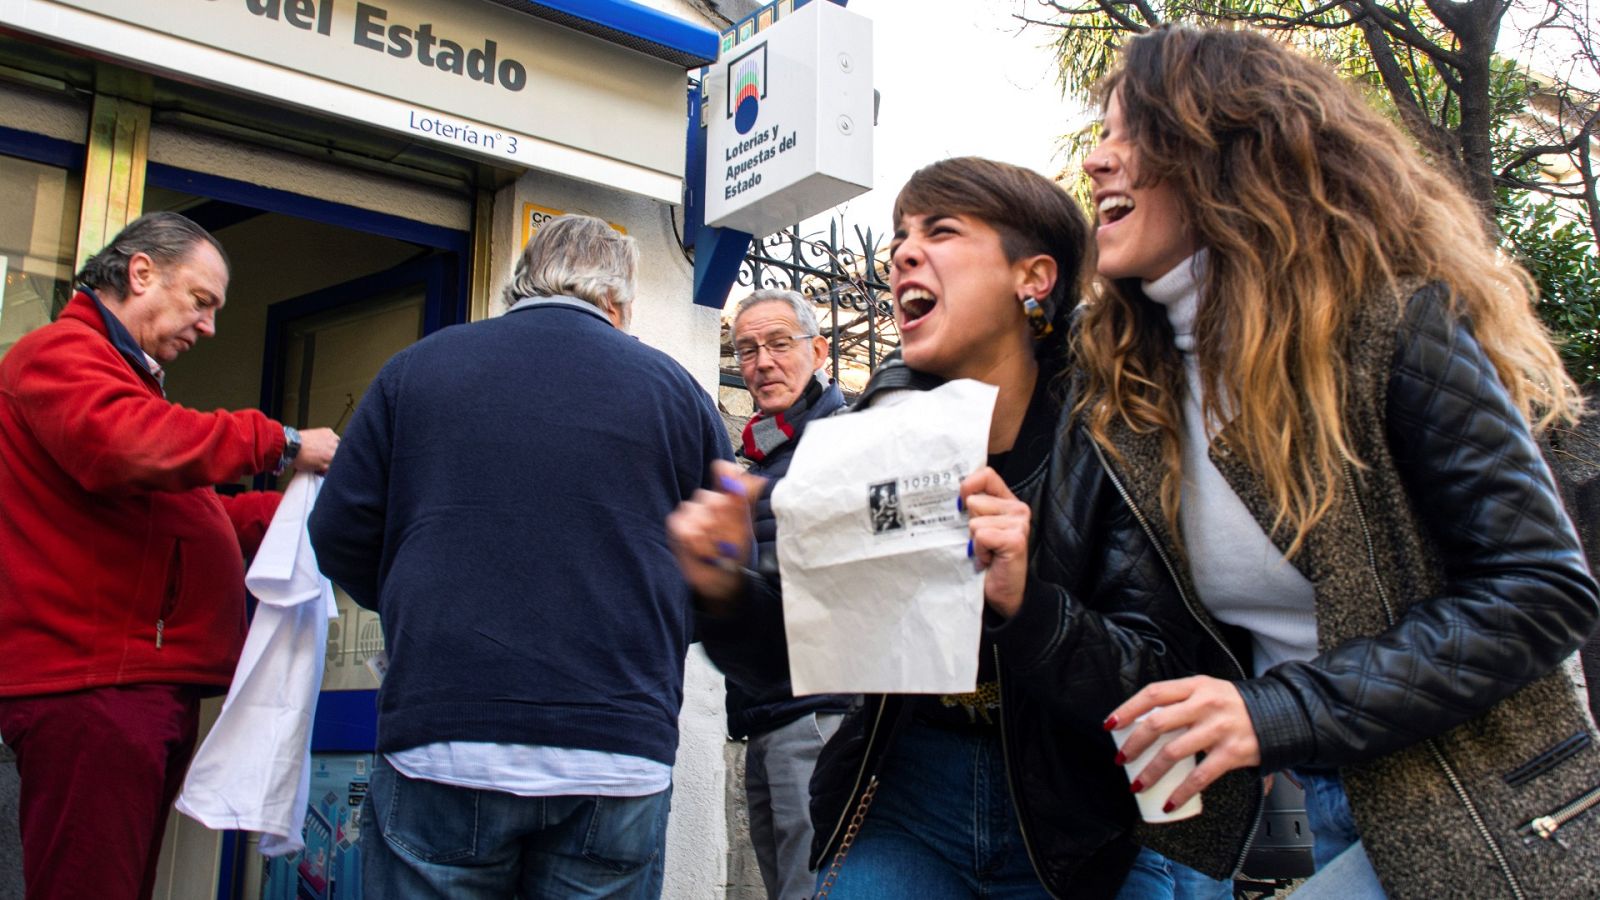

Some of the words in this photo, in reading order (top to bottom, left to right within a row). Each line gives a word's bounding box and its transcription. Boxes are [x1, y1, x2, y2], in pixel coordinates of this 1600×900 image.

[353, 3, 527, 92] Estado
[410, 111, 478, 145] Lotería
[507, 136, 518, 154] 3
[772, 124, 779, 141] y
[726, 146, 776, 181] Apuestas
[779, 131, 797, 153] del
[725, 172, 762, 200] Estado
